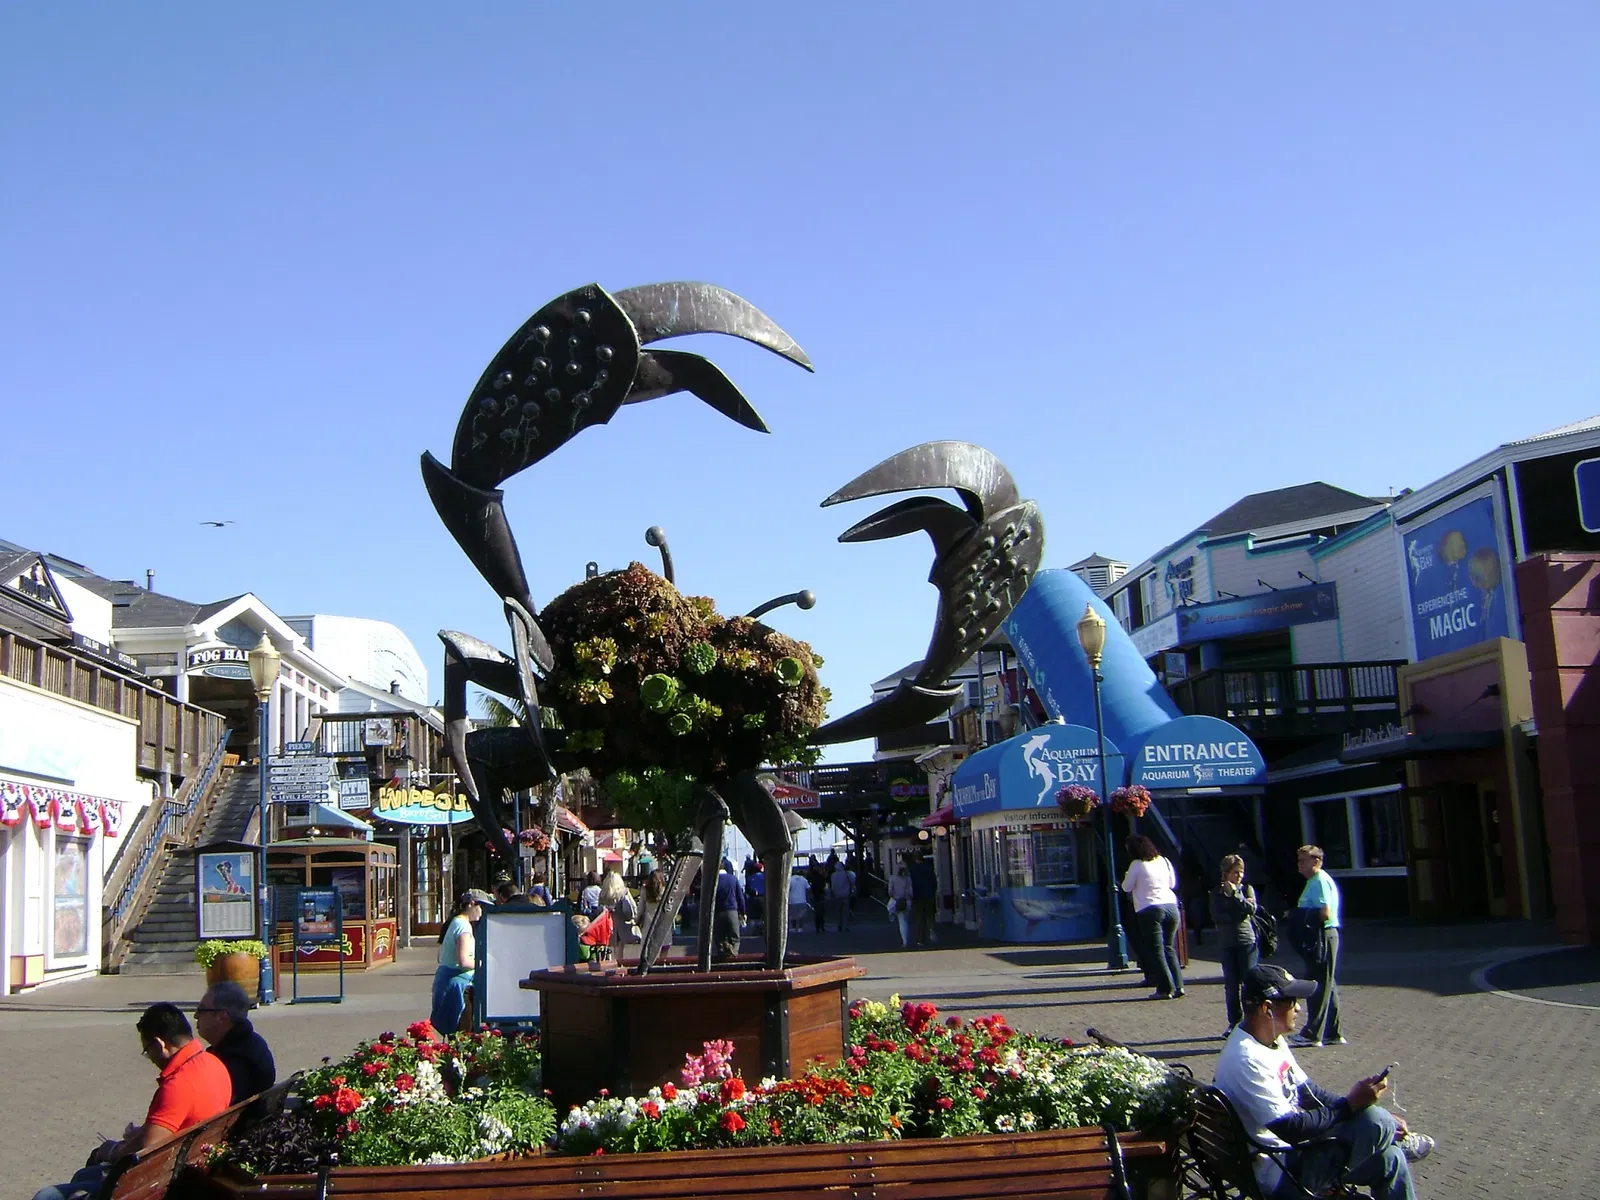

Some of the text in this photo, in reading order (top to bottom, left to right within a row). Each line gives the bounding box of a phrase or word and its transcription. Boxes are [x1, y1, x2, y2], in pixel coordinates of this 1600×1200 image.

[1417, 587, 1468, 615] EXPERIENCE THE
[1430, 603, 1477, 640] MAGIC
[192, 649, 220, 664] FOG
[1144, 741, 1248, 762] ENTRANCE
[1057, 763, 1098, 783] BAY
[1141, 767, 1256, 781] AQUARIUM THEATER
[342, 781, 367, 795] ATM
[1004, 812, 1027, 821] Visitor
